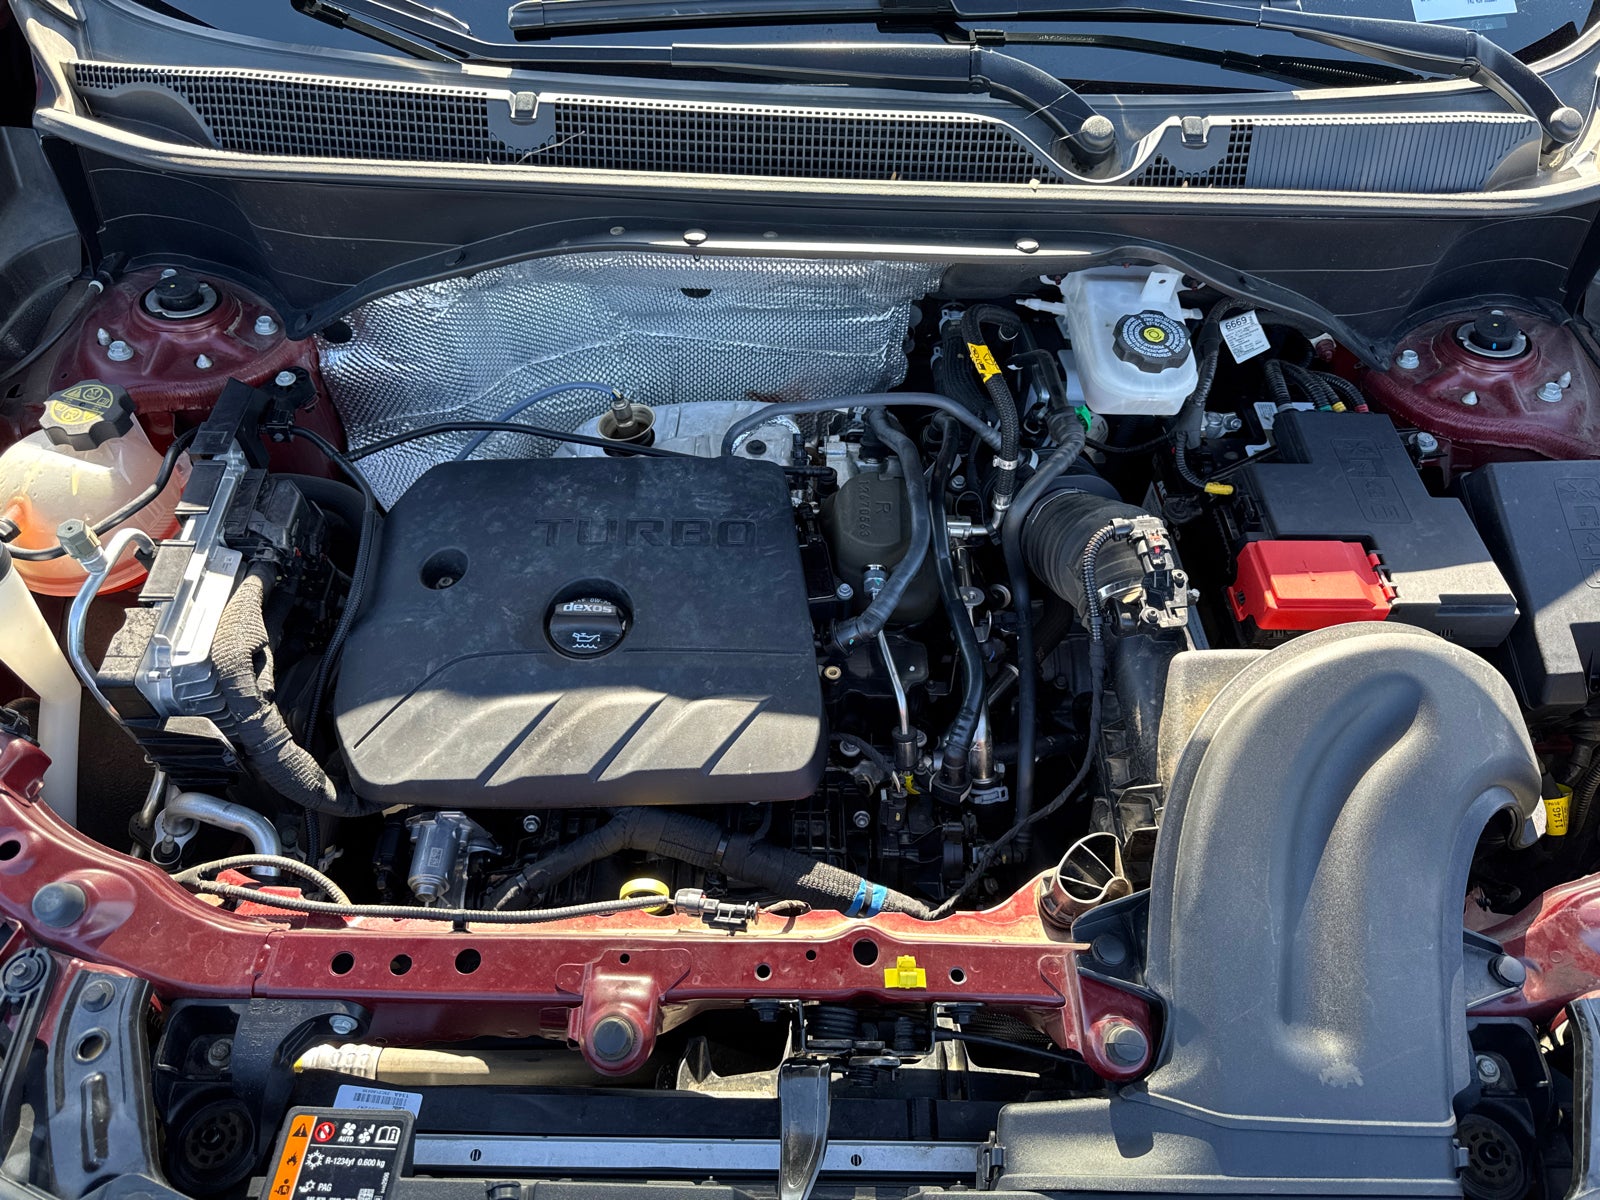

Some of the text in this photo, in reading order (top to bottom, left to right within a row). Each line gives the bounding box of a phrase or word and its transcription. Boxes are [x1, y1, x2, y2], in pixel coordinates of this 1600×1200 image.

[1225, 316, 1247, 330] 6669
[875, 502, 892, 514] R
[534, 517, 757, 547] TURBO
[563, 602, 612, 613] dexos
[1552, 807, 1564, 828] 1146
[338, 1135, 354, 1143] AUTO
[324, 1156, 386, 1169] R-1234yf 0.600 kg
[317, 1182, 332, 1192] PAG
